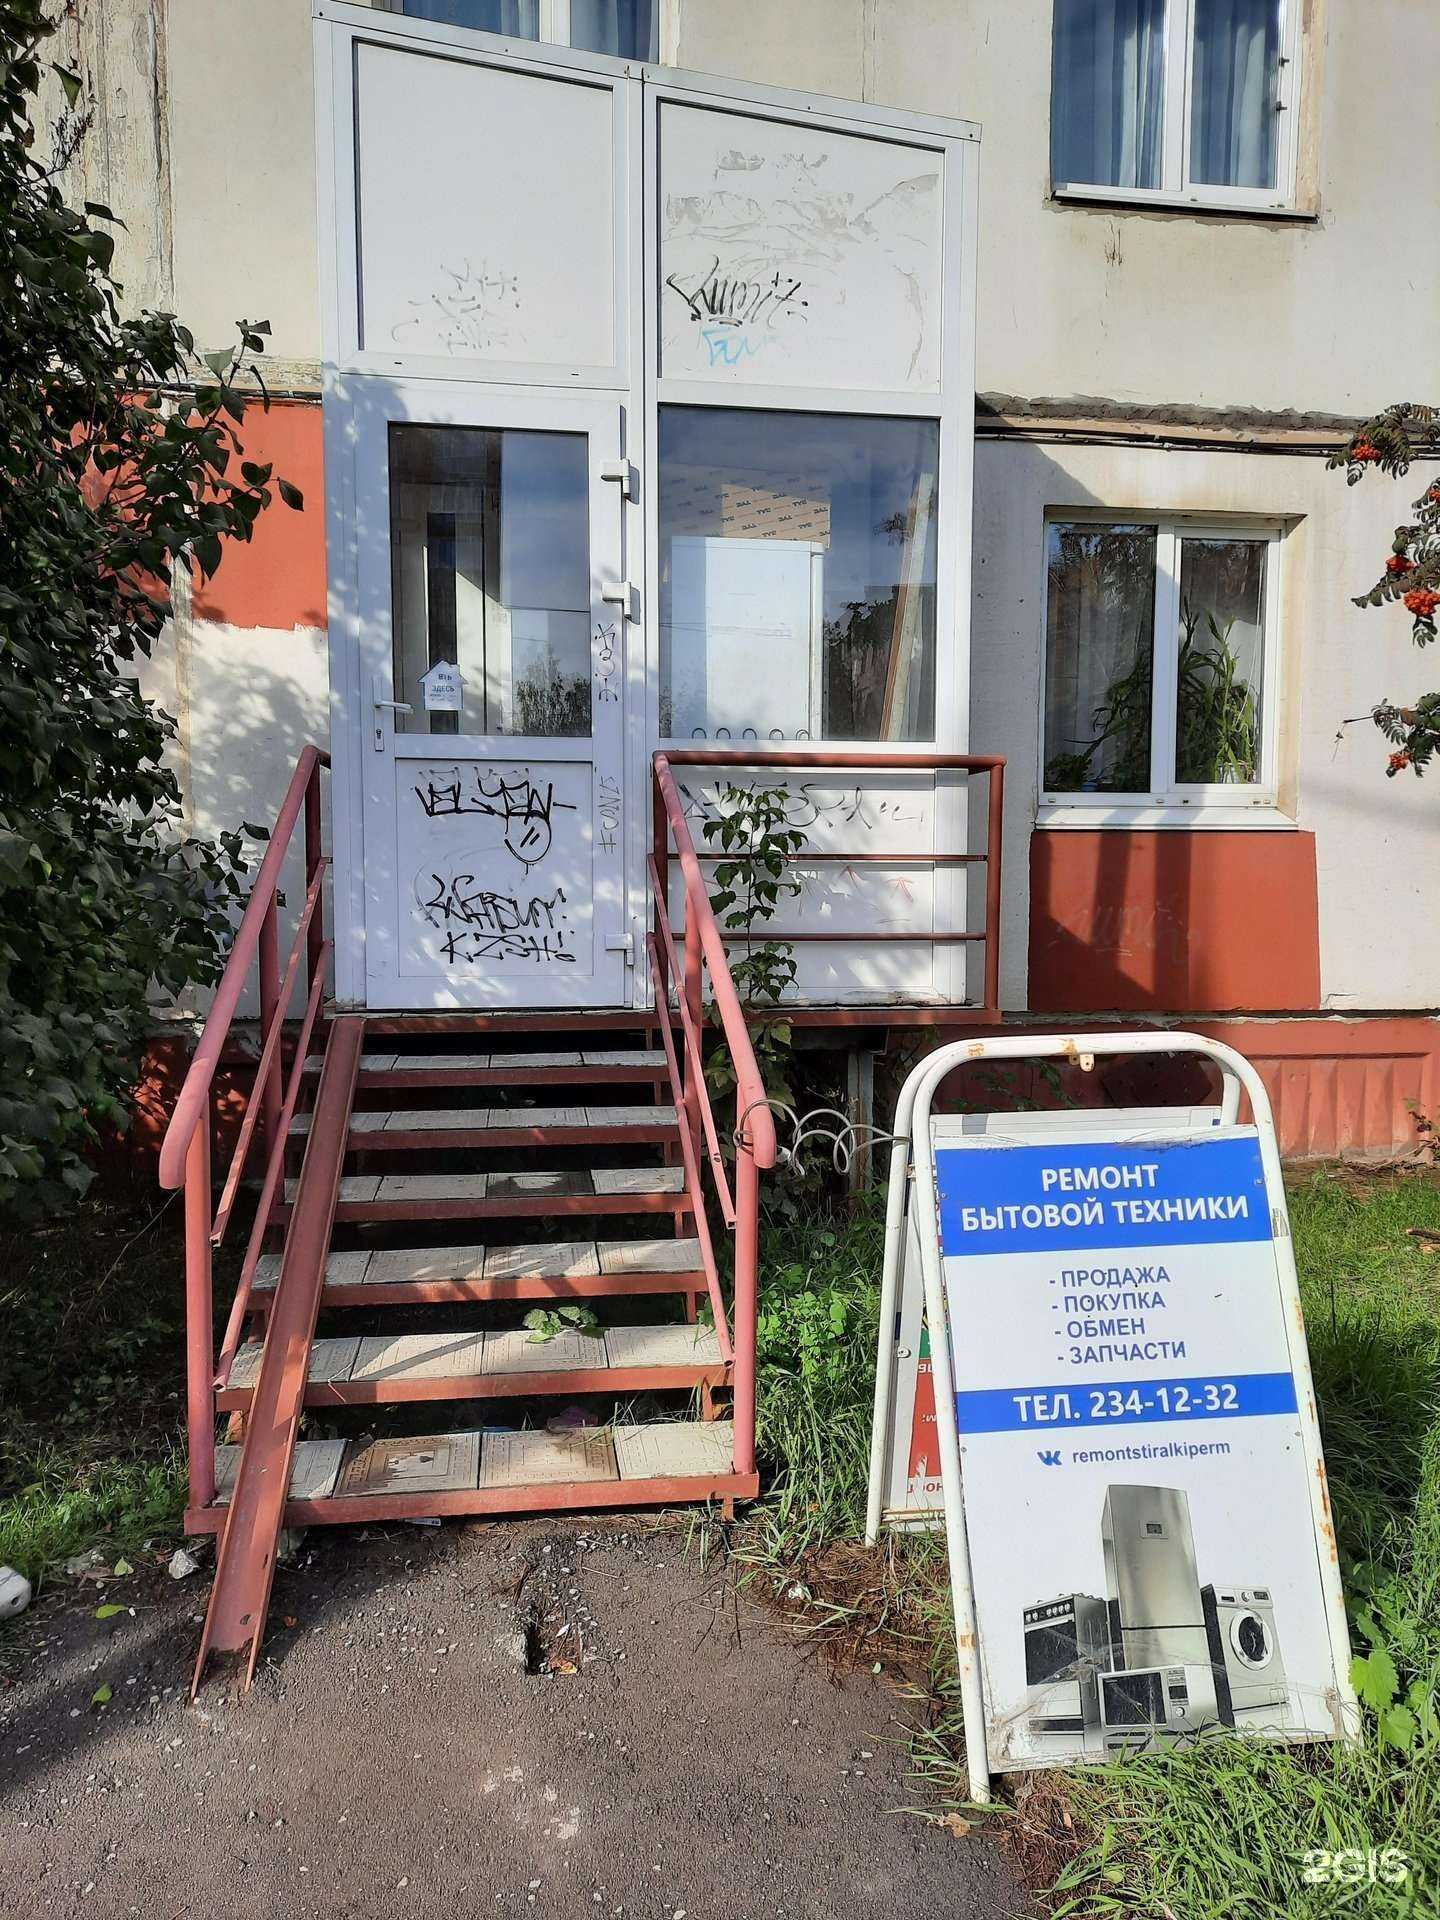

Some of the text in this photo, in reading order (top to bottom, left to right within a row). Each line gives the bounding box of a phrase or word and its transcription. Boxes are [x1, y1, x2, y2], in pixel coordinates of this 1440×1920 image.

[1041, 1164, 1159, 1192] РЕМОНТ
[961, 1195, 1249, 1232] БЫТОВОЙ ТЕХНИКИ
[1061, 1266, 1171, 1288] ПРОДАЖА
[1064, 1291, 1166, 1313] ПОКУПКА
[1067, 1318, 1145, 1339] ОБМЕН
[1069, 1341, 1186, 1364] ЗАПЧАСТИ
[1012, 1383, 1240, 1422] ТЕЛ. 234-12-32
[1072, 1440, 1231, 1464] remontstiralkiperm
